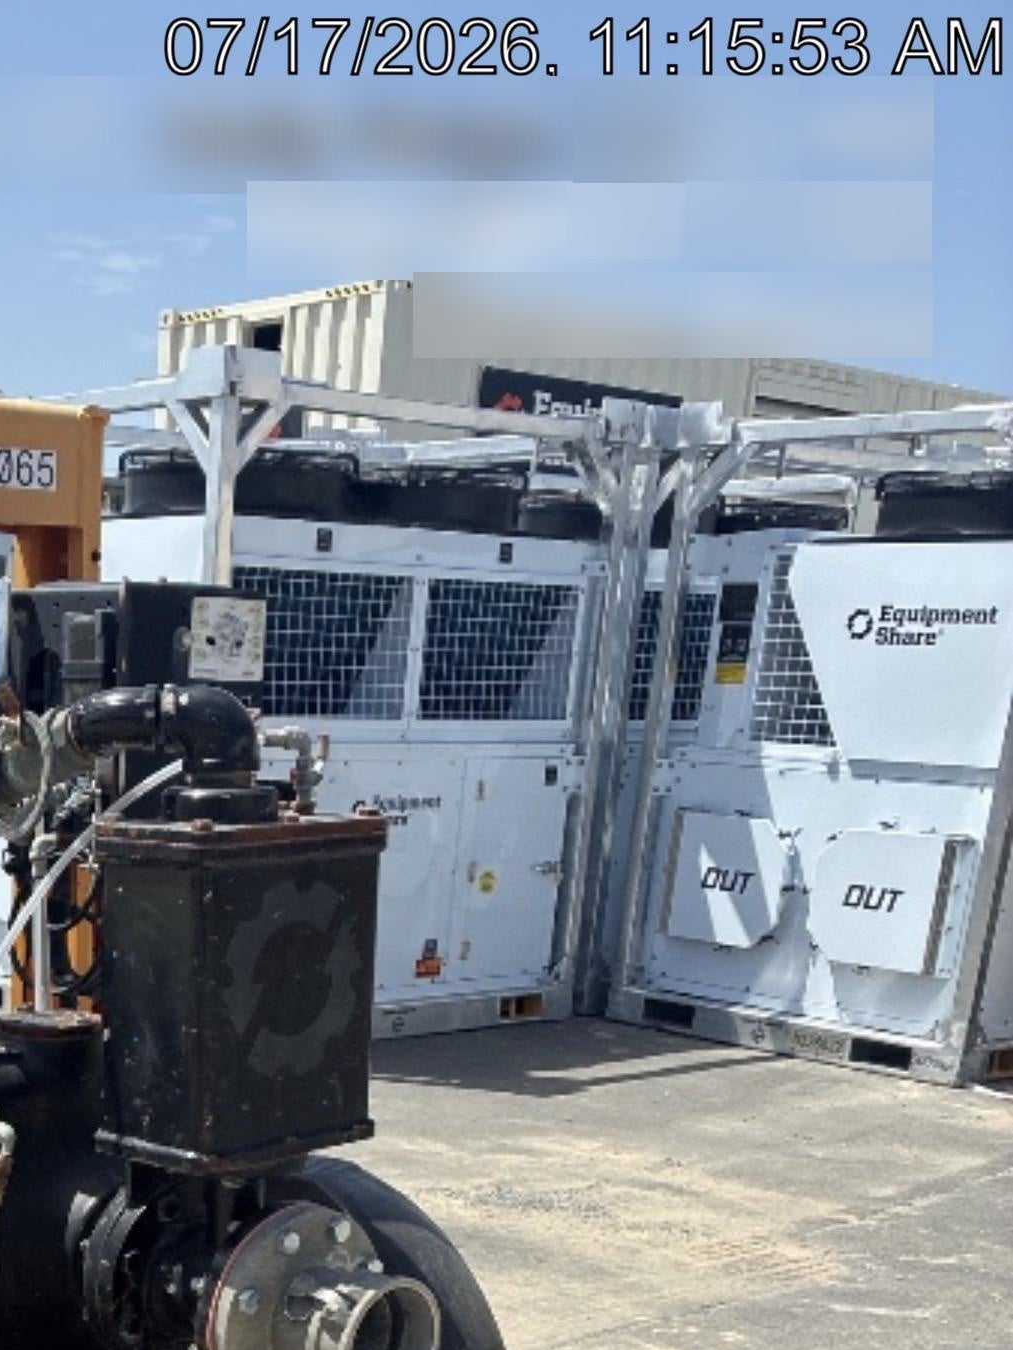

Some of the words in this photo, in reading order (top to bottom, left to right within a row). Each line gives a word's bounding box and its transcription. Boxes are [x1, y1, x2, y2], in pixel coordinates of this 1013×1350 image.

[878, 605, 999, 627] Equipment
[701, 866, 755, 895] OUT
[842, 884, 905, 913] OUT
